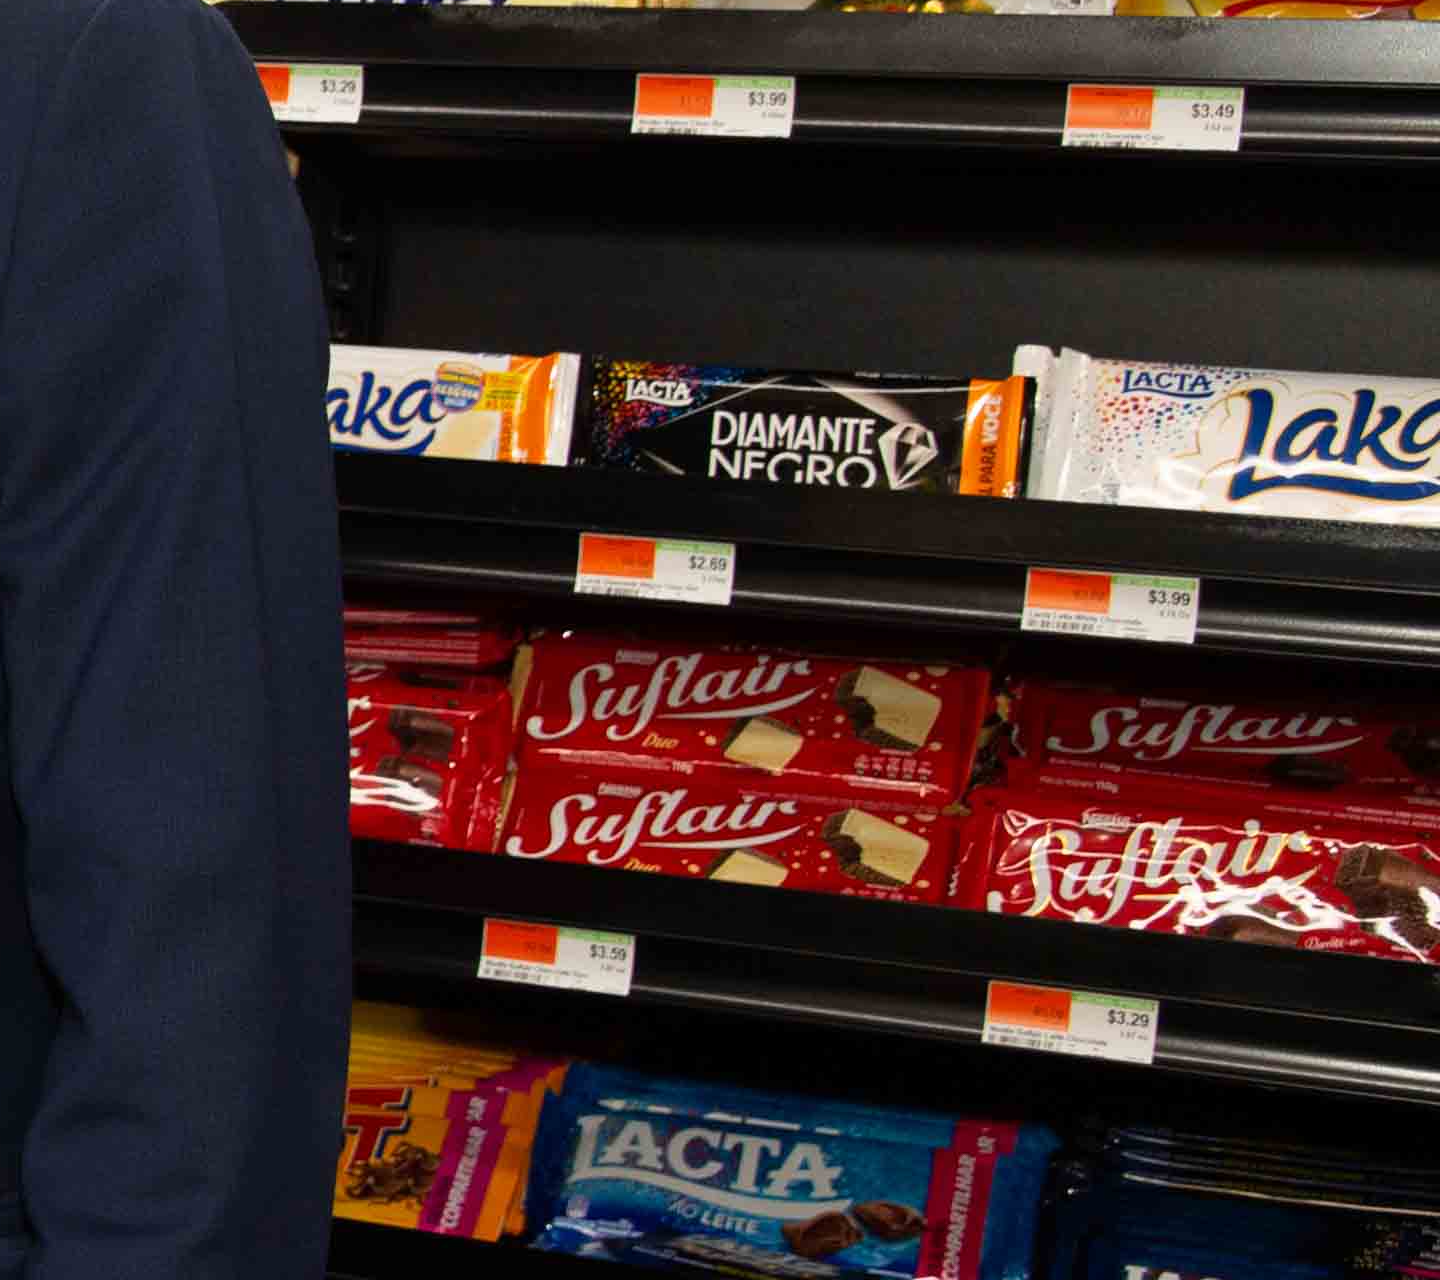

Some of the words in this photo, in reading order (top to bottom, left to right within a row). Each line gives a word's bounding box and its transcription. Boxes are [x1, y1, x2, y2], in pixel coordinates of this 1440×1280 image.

[320, 79, 357, 95] $3.29
[748, 91, 788, 107] $3.99
[1191, 103, 1235, 119] $3.49
[626, 378, 693, 408] LACTA
[1121, 369, 1215, 400] LACTA
[709, 410, 877, 455] DIAMANTE
[1147, 590, 1191, 608] $3.99
[523, 652, 814, 742] Suflair
[1045, 704, 1363, 761] Suflair
[501, 788, 804, 866] Suflair
[984, 816, 1320, 925] Suflair
[1107, 1008, 1150, 1029] $3.29
[569, 1113, 852, 1219] LACTA
[699, 1205, 761, 1235] LEITE
